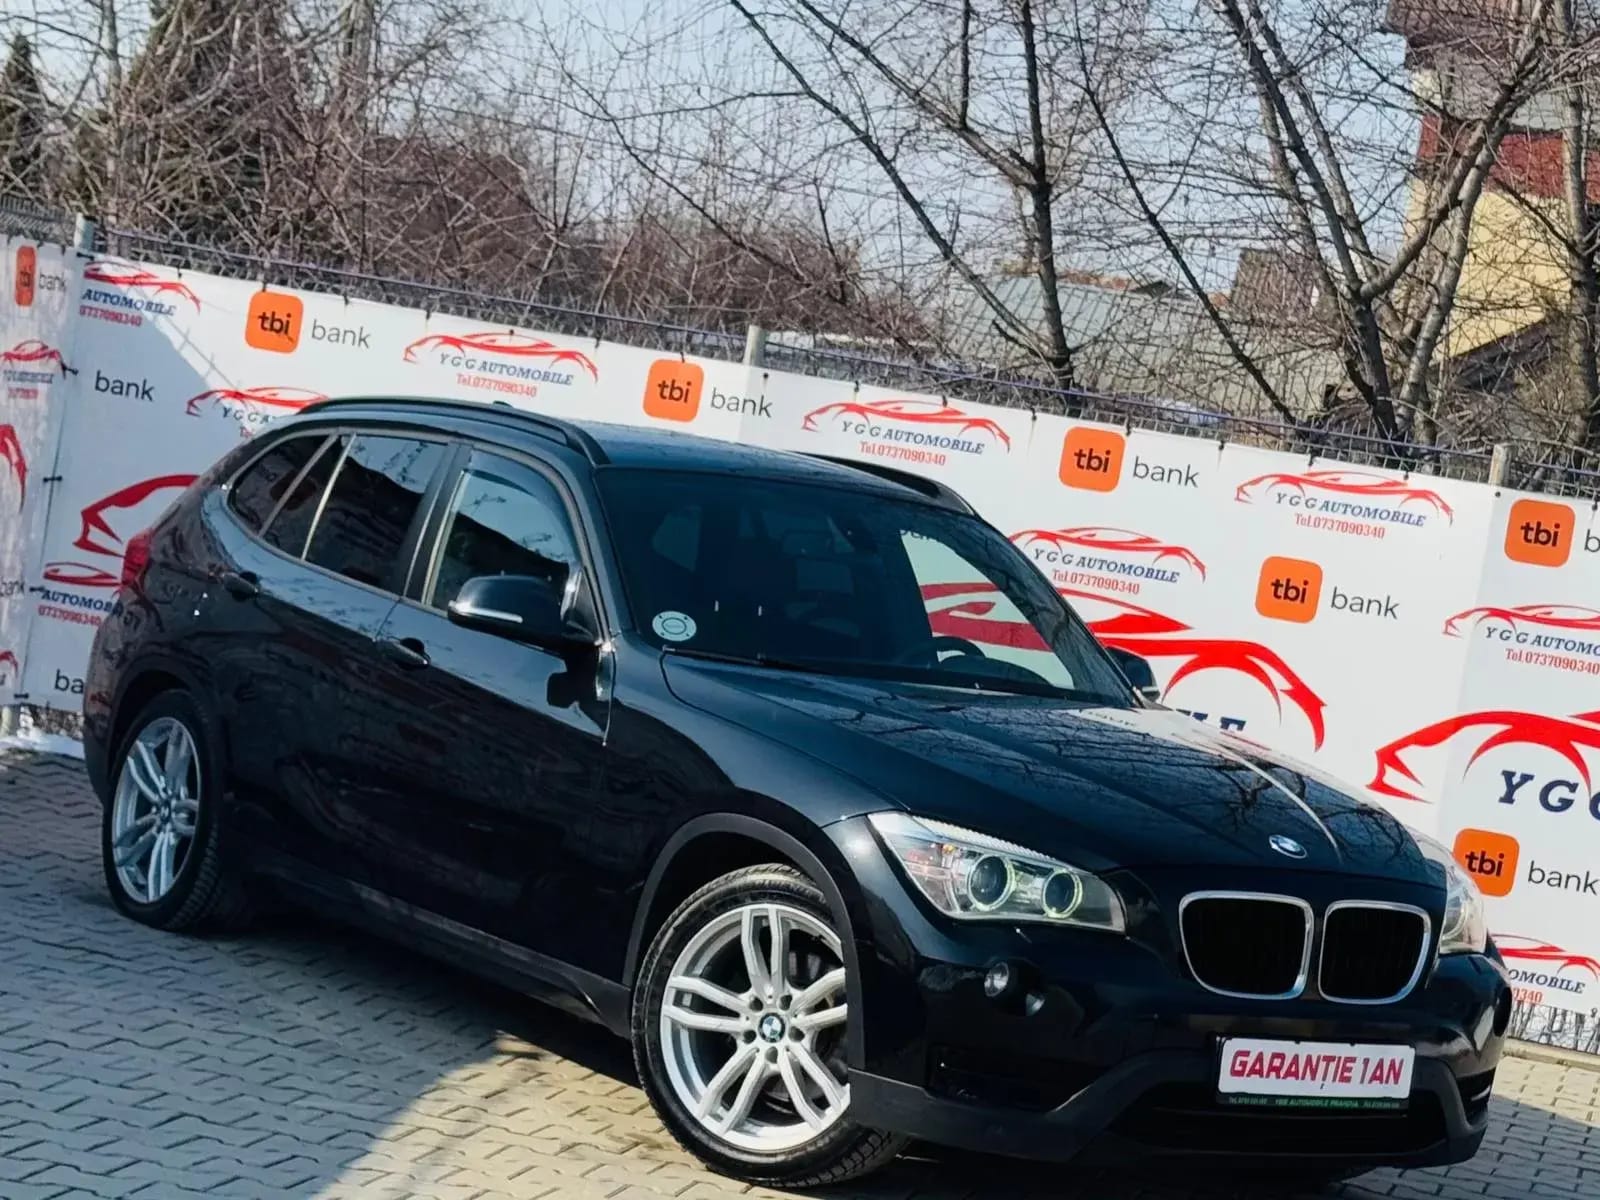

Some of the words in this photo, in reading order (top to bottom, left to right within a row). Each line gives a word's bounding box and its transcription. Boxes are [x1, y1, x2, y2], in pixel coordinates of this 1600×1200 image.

[82, 289, 176, 316] AUTOMOBILE
[258, 310, 292, 336] tbi
[311, 319, 371, 349] bank
[94, 370, 155, 401] bank
[477, 361, 575, 386] AUTOMOBILE
[657, 379, 692, 404] tbi
[710, 387, 773, 418] bank
[882, 428, 985, 455] AUTOMOBILE
[1074, 448, 1111, 473] tbi
[1132, 456, 1200, 488] bank
[1318, 500, 1427, 527] AUTOMOBILE
[1520, 521, 1561, 547] tbi
[1075, 556, 1180, 583] AUTOMOBILE
[41, 589, 113, 612] AUTOMOB
[1270, 578, 1309, 603] tbi
[1330, 586, 1400, 620] bank
[1531, 634, 1600, 657] AUTOMO
[54, 668, 84, 694] ba
[1465, 850, 1504, 877] tbi
[1527, 860, 1600, 896] bank
[1508, 968, 1585, 994] OMOBILE
